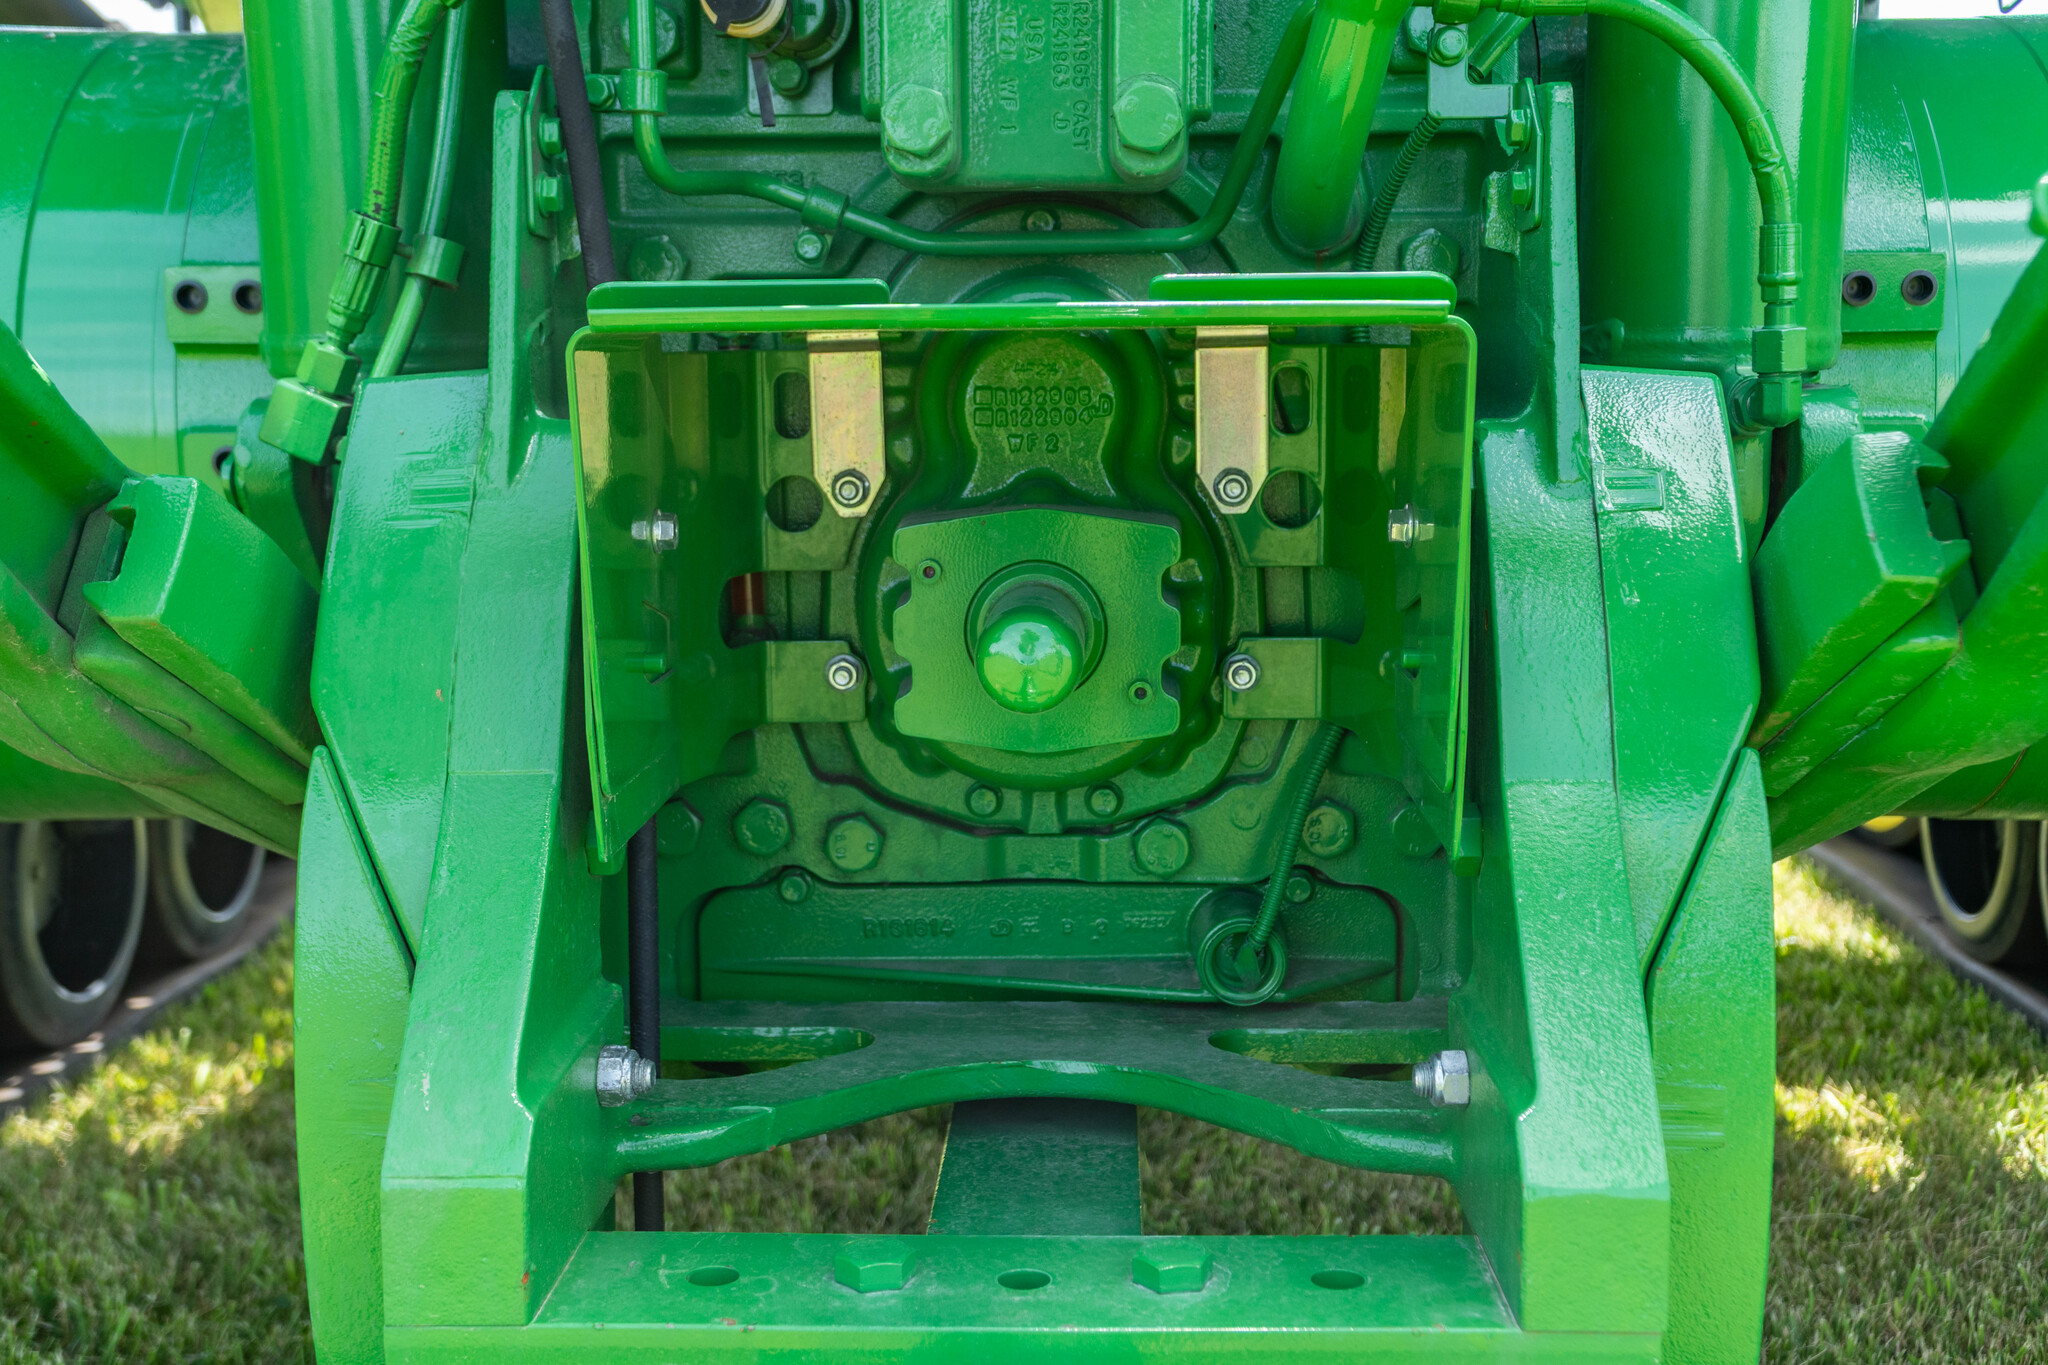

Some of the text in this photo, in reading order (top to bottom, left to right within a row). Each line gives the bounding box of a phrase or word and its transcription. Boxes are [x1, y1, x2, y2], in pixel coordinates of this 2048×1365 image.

[1024, 17, 1043, 62] USA
[1051, 1, 1071, 89] R241963
[1000, 78, 1019, 111] WF
[1072, 1, 1091, 152] R241965 CAST
[1006, 433, 1060, 453] WF 2
